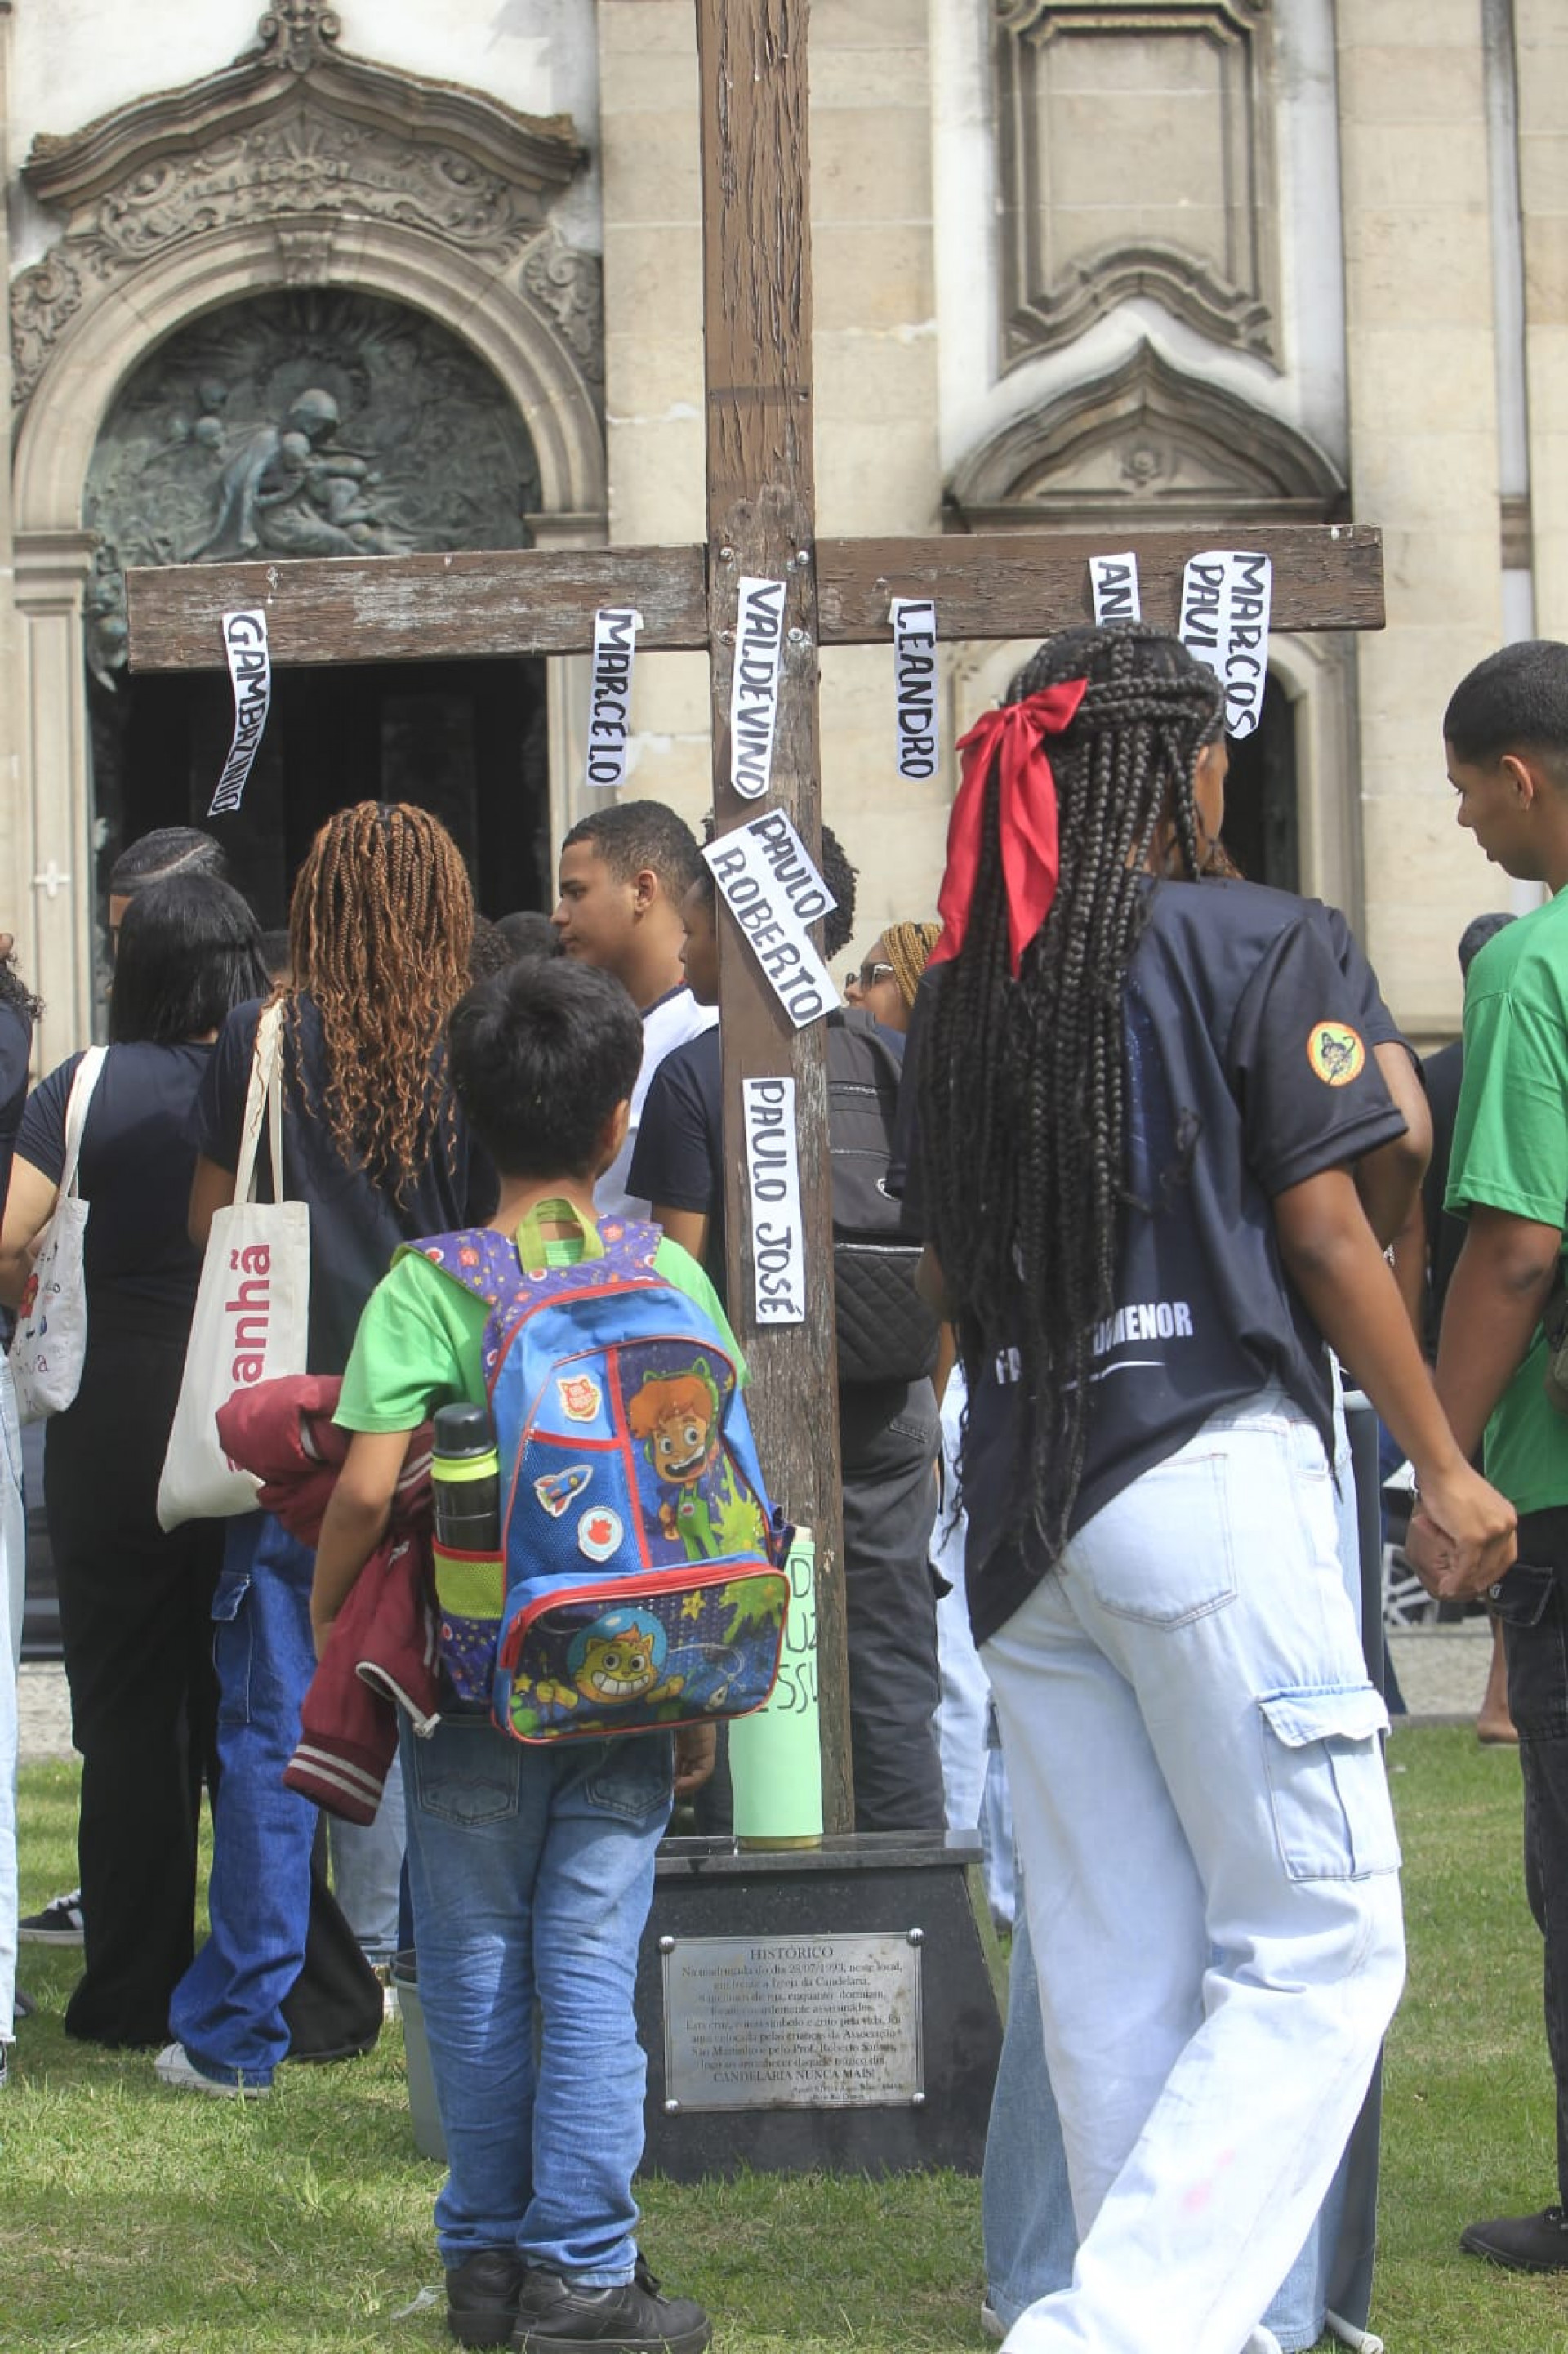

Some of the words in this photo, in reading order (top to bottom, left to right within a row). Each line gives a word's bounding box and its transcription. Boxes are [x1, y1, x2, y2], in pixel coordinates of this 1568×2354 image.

[590, 609, 632, 783] MARCELO
[733, 582, 782, 796] VALDEVINO
[898, 601, 935, 779] LEANDRO
[1225, 554, 1266, 733] MARCOS
[711, 846, 823, 1021] ROBERTO
[747, 814, 826, 919] PAULO
[749, 1080, 786, 1202] PAULO
[755, 1222, 804, 1320] JOSÉ
[751, 1945, 834, 1961] HISTÓRICO
[796, 2069, 840, 2080] NUNCA
